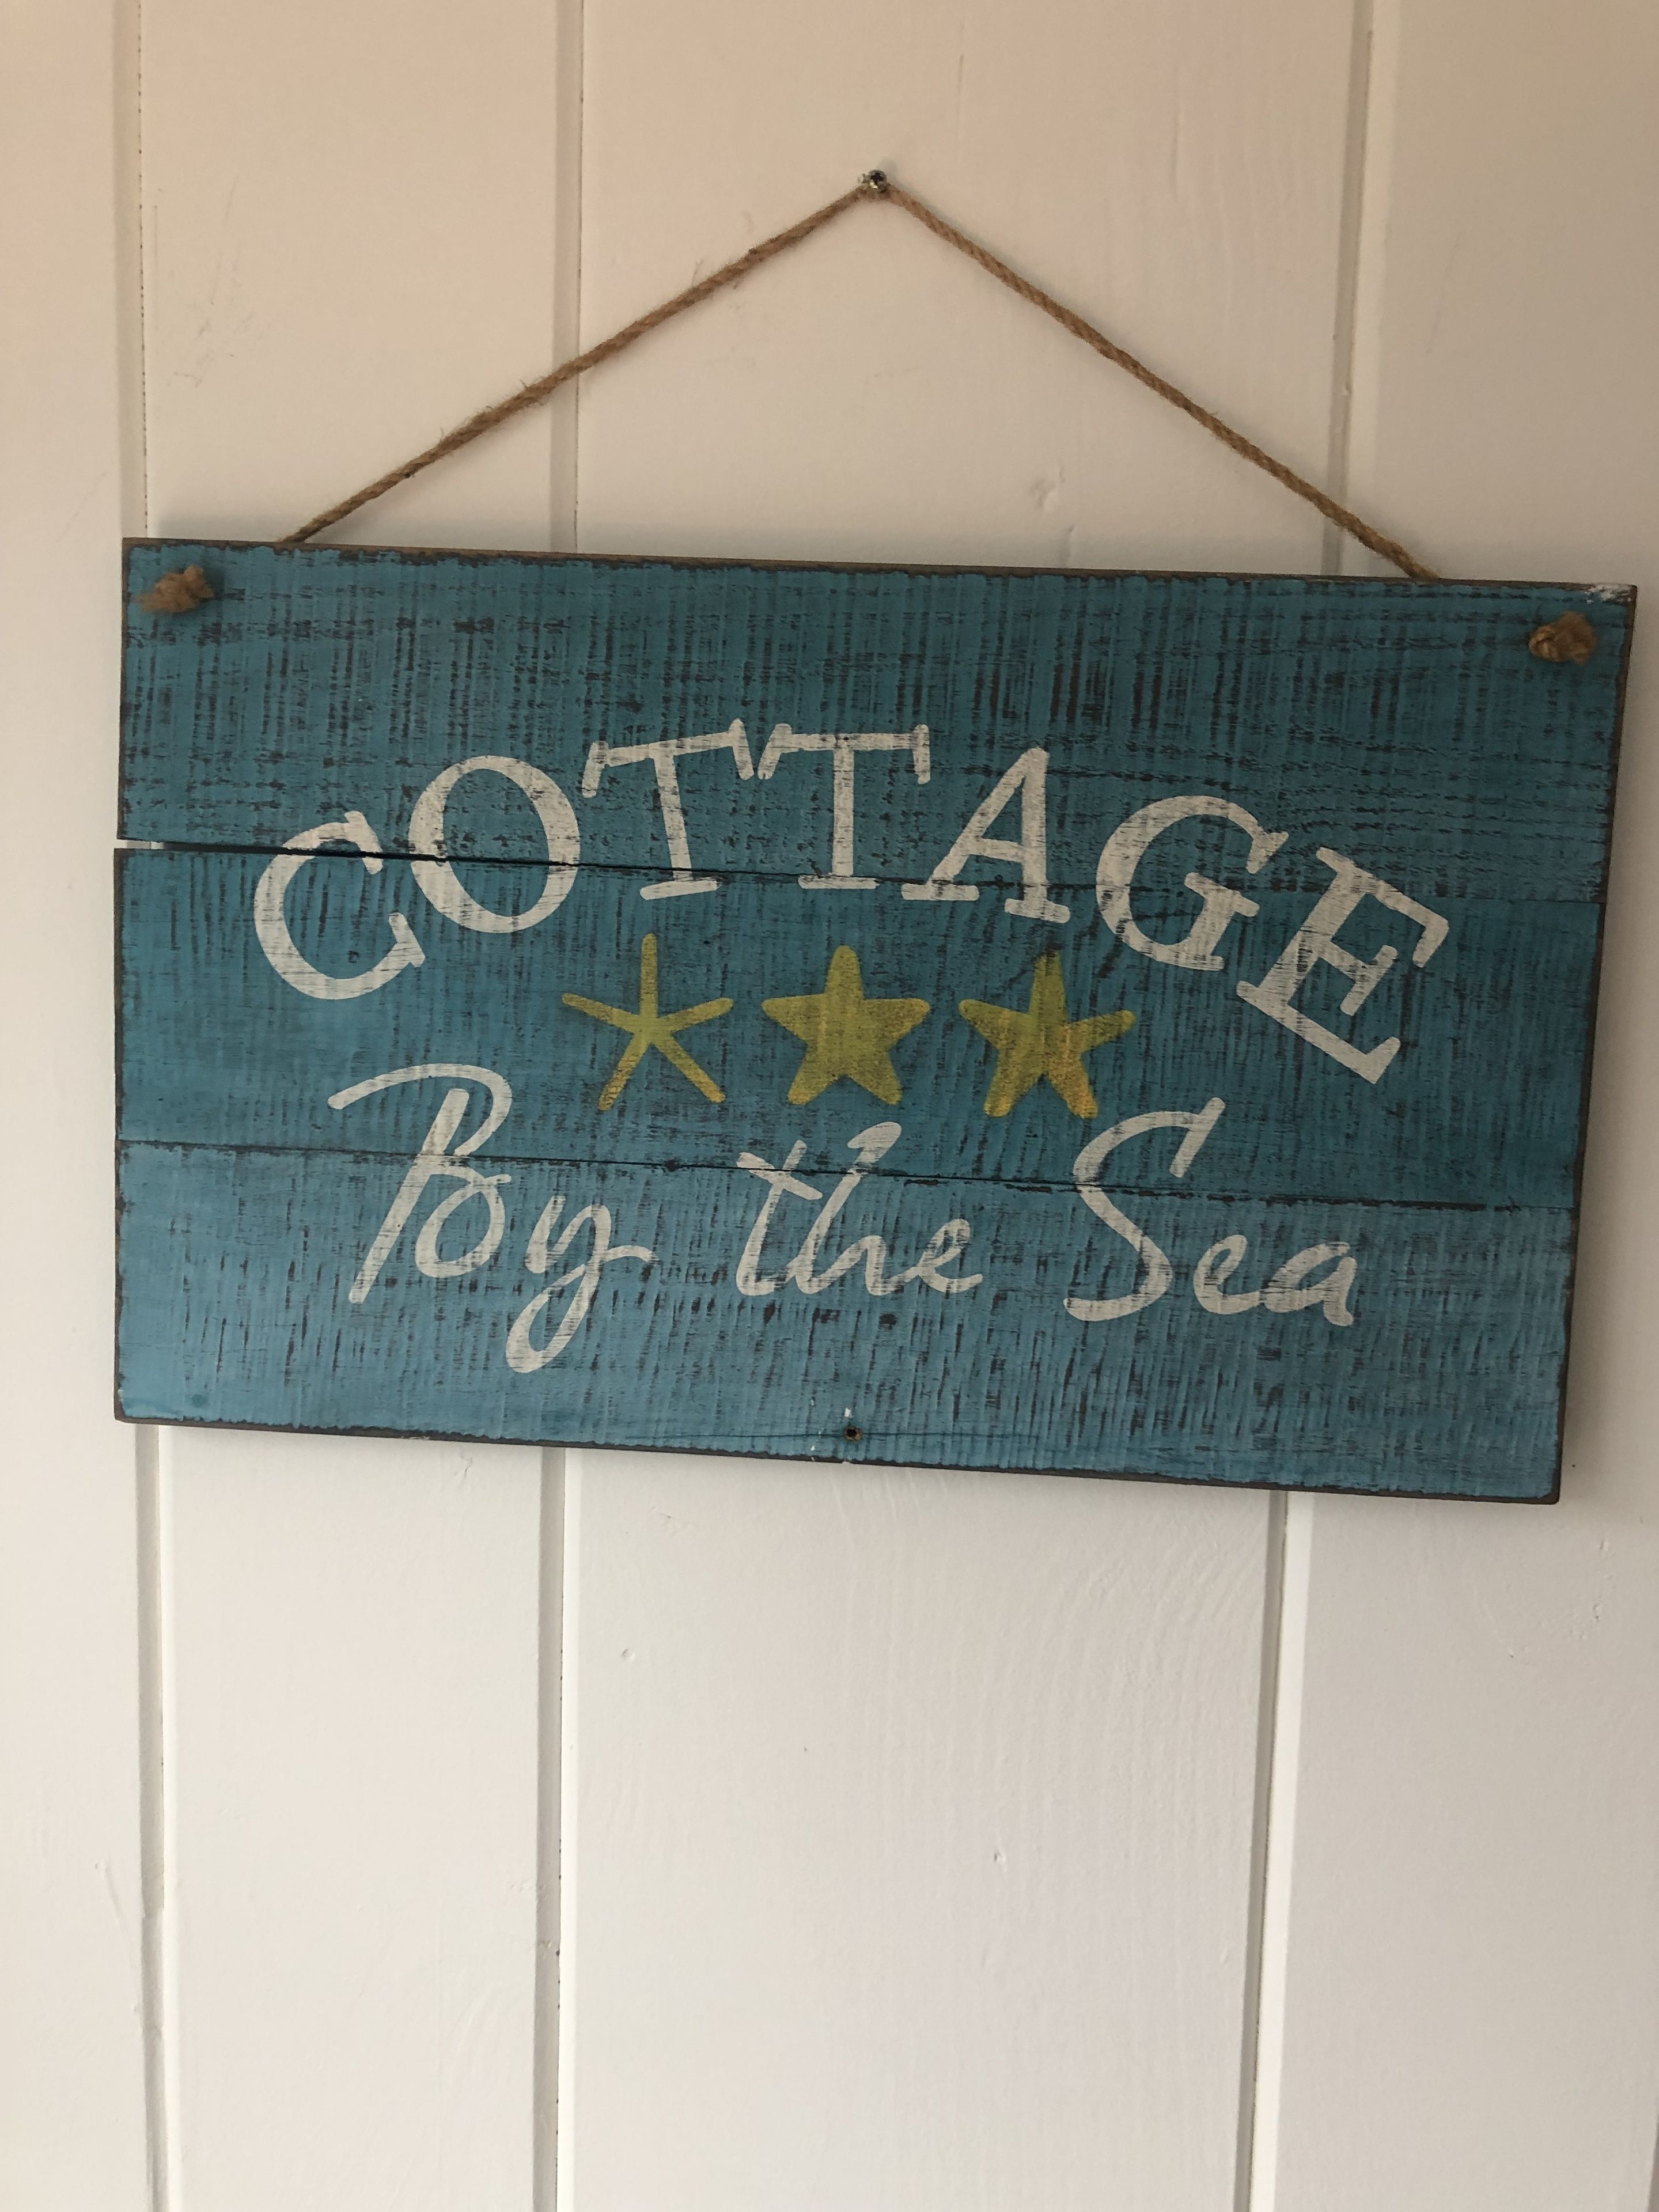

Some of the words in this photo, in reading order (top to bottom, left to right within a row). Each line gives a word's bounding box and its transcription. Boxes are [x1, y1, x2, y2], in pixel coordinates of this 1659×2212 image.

[253, 719, 1450, 1084] COTTAGE
[328, 1063, 657, 1374] By
[736, 1122, 983, 1297] the
[1066, 1097, 1356, 1327] Sea
